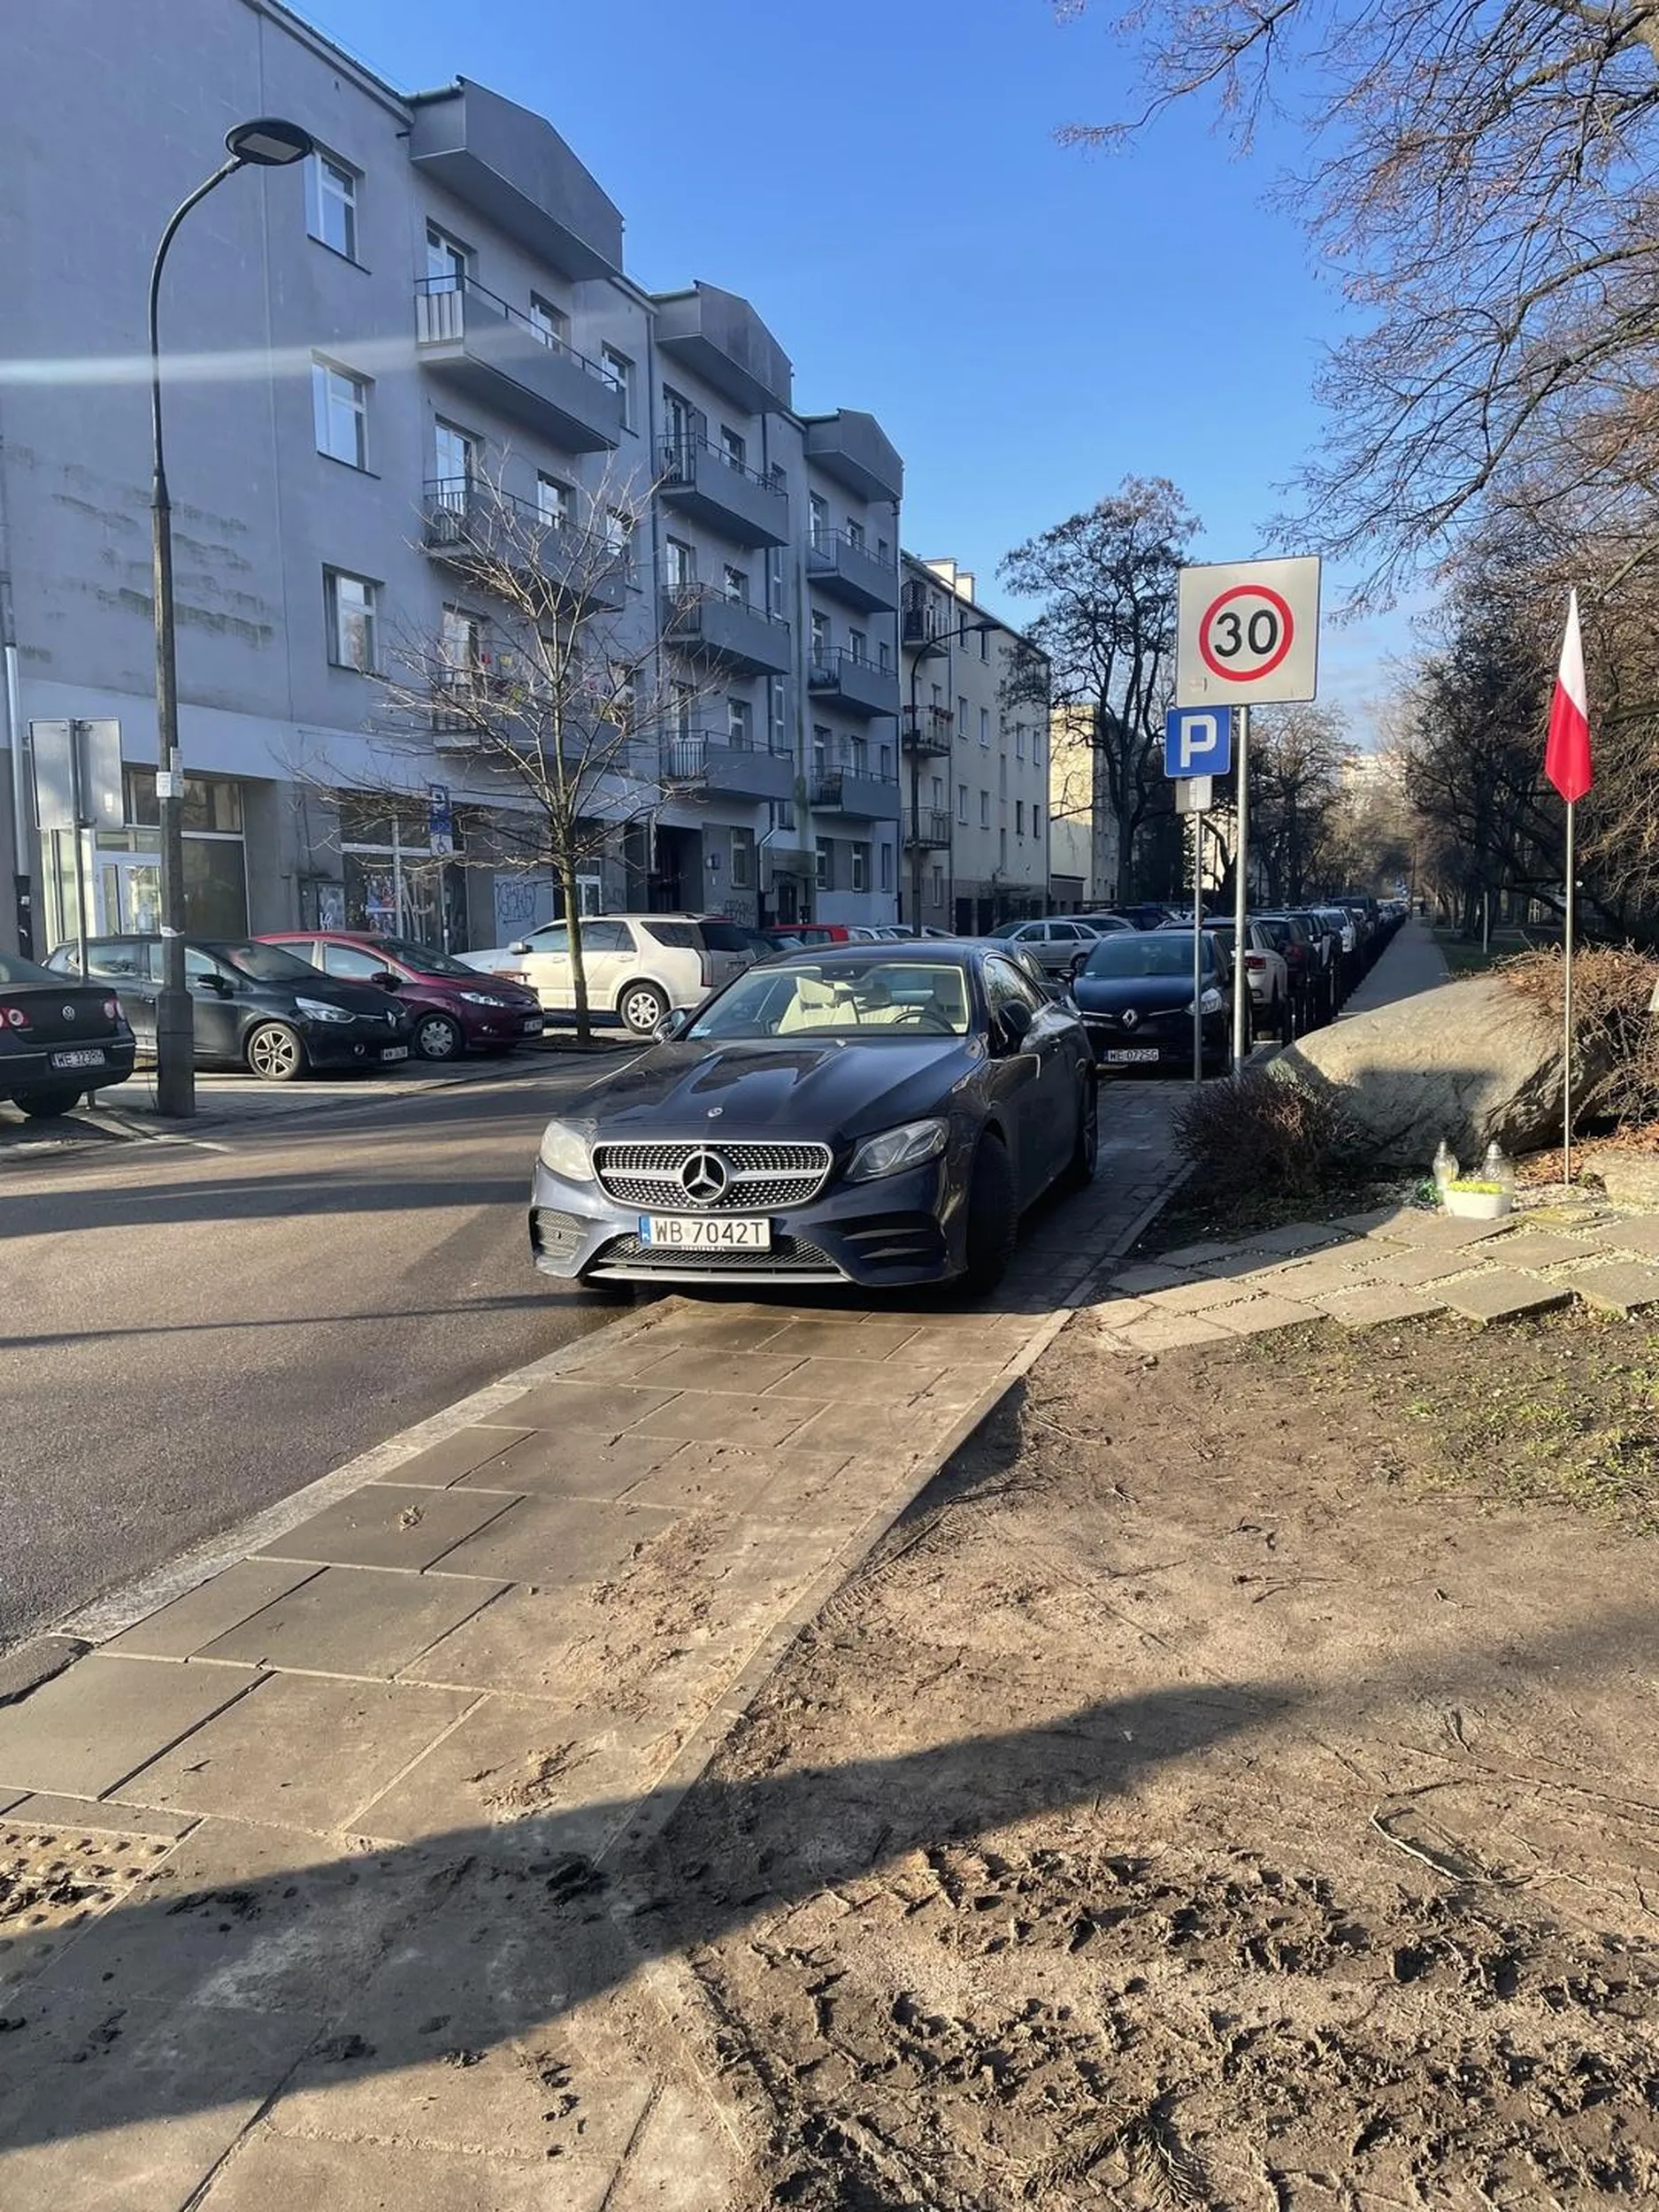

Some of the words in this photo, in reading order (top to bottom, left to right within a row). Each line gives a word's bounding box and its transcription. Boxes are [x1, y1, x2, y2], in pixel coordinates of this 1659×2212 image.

[1214, 610, 1278, 657] 30
[1180, 715, 1217, 768] P
[1110, 1050, 1124, 1061] WE
[655, 1220, 683, 1242] WB
[692, 1222, 764, 1244] 7042T
